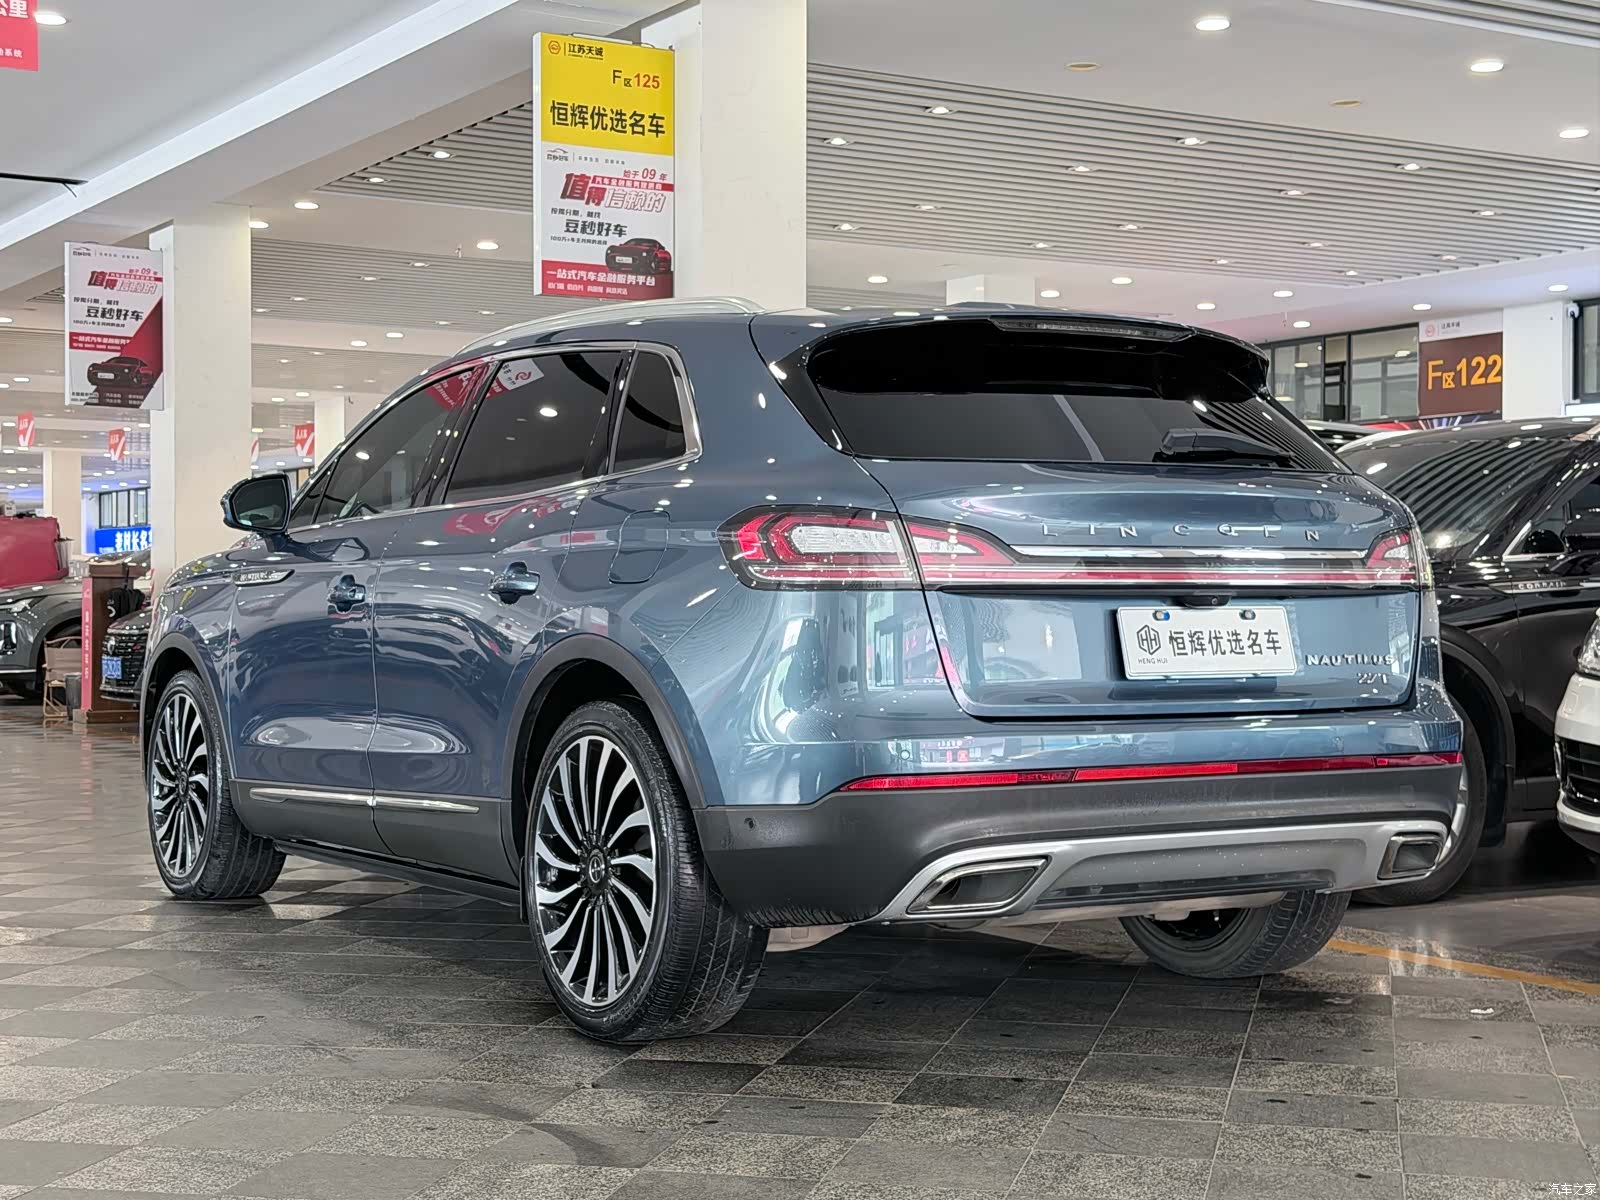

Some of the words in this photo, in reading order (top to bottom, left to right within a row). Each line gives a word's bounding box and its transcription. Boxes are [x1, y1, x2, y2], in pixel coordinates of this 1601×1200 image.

[568, 43, 604, 57] 江苏天诚
[550, 100, 666, 138] 恒辉优选名车
[641, 168, 657, 180] 09
[564, 219, 628, 238] 豆秒好车
[85, 305, 144, 322] 豆秒好车
[1427, 354, 1502, 391] F区122
[1042, 523, 1321, 541] LINCOLN
[1168, 629, 1282, 657] 恒辉优选名车
[1304, 653, 1395, 667] NAUTILUS
